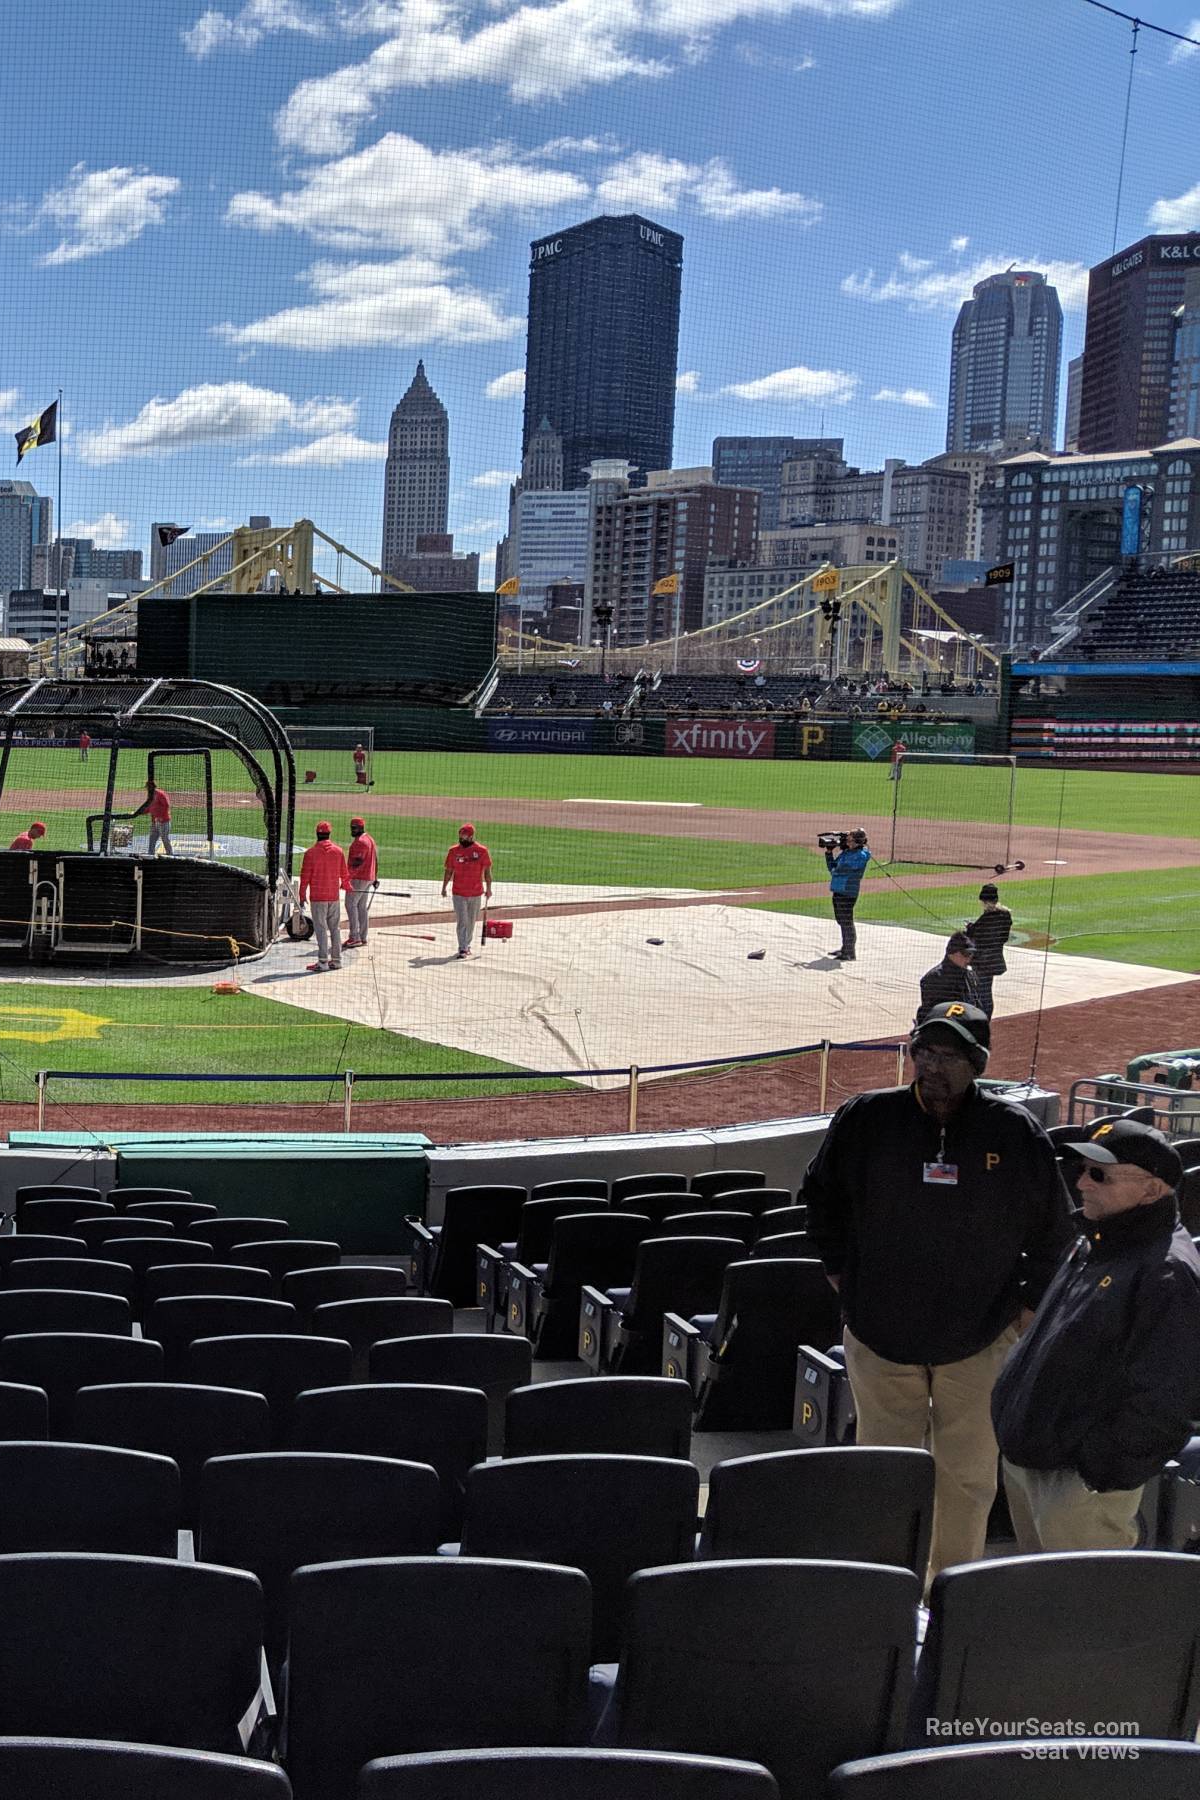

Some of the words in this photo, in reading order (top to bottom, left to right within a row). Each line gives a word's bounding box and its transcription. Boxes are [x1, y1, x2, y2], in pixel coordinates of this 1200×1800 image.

[639, 224, 665, 247] UPMC
[531, 239, 563, 262] UPMC
[1160, 245, 1190, 259] K&L
[815, 575, 836, 587] 1903
[988, 568, 1011, 580] 1909
[521, 730, 586, 742] HYUNDAI
[672, 723, 768, 755] xfinity
[801, 725, 824, 756] P
[900, 731, 974, 748] Allegheny
[945, 1004, 965, 1018] P
[1091, 1124, 1114, 1141] P
[986, 1152, 1001, 1171] P
[479, 1281, 487, 1297] P
[511, 1303, 519, 1321] P
[583, 1331, 592, 1350] P
[802, 1402, 813, 1425] P
